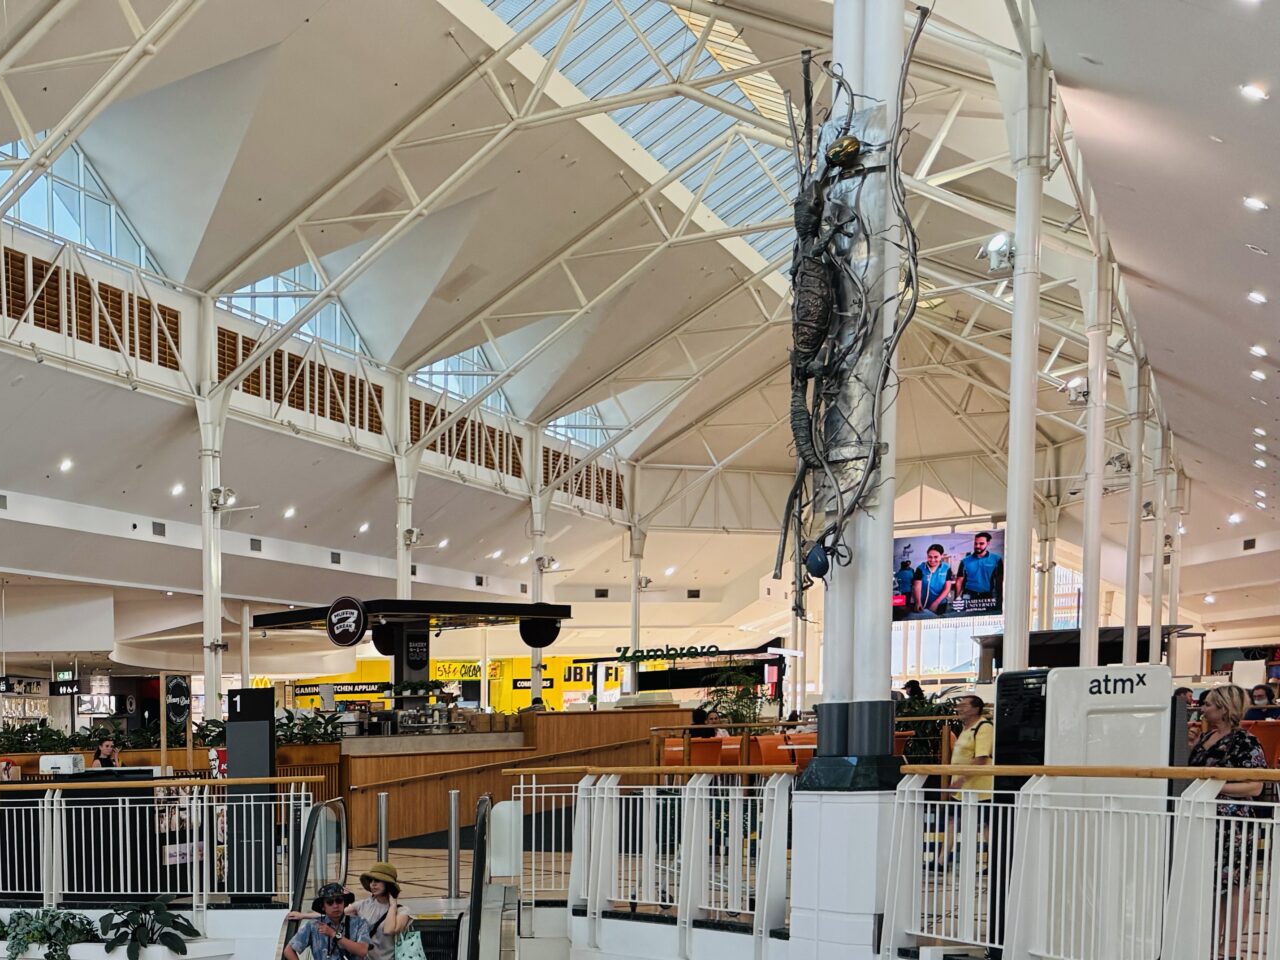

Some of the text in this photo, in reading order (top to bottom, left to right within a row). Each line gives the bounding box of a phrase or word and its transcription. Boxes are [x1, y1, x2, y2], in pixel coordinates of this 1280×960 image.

[333, 609, 355, 619] MUFFIN
[336, 623, 353, 631] BREAK
[615, 644, 720, 663] Zambrero
[563, 666, 583, 682] JB
[295, 686, 319, 694] GAMIN
[232, 694, 241, 713] 1
